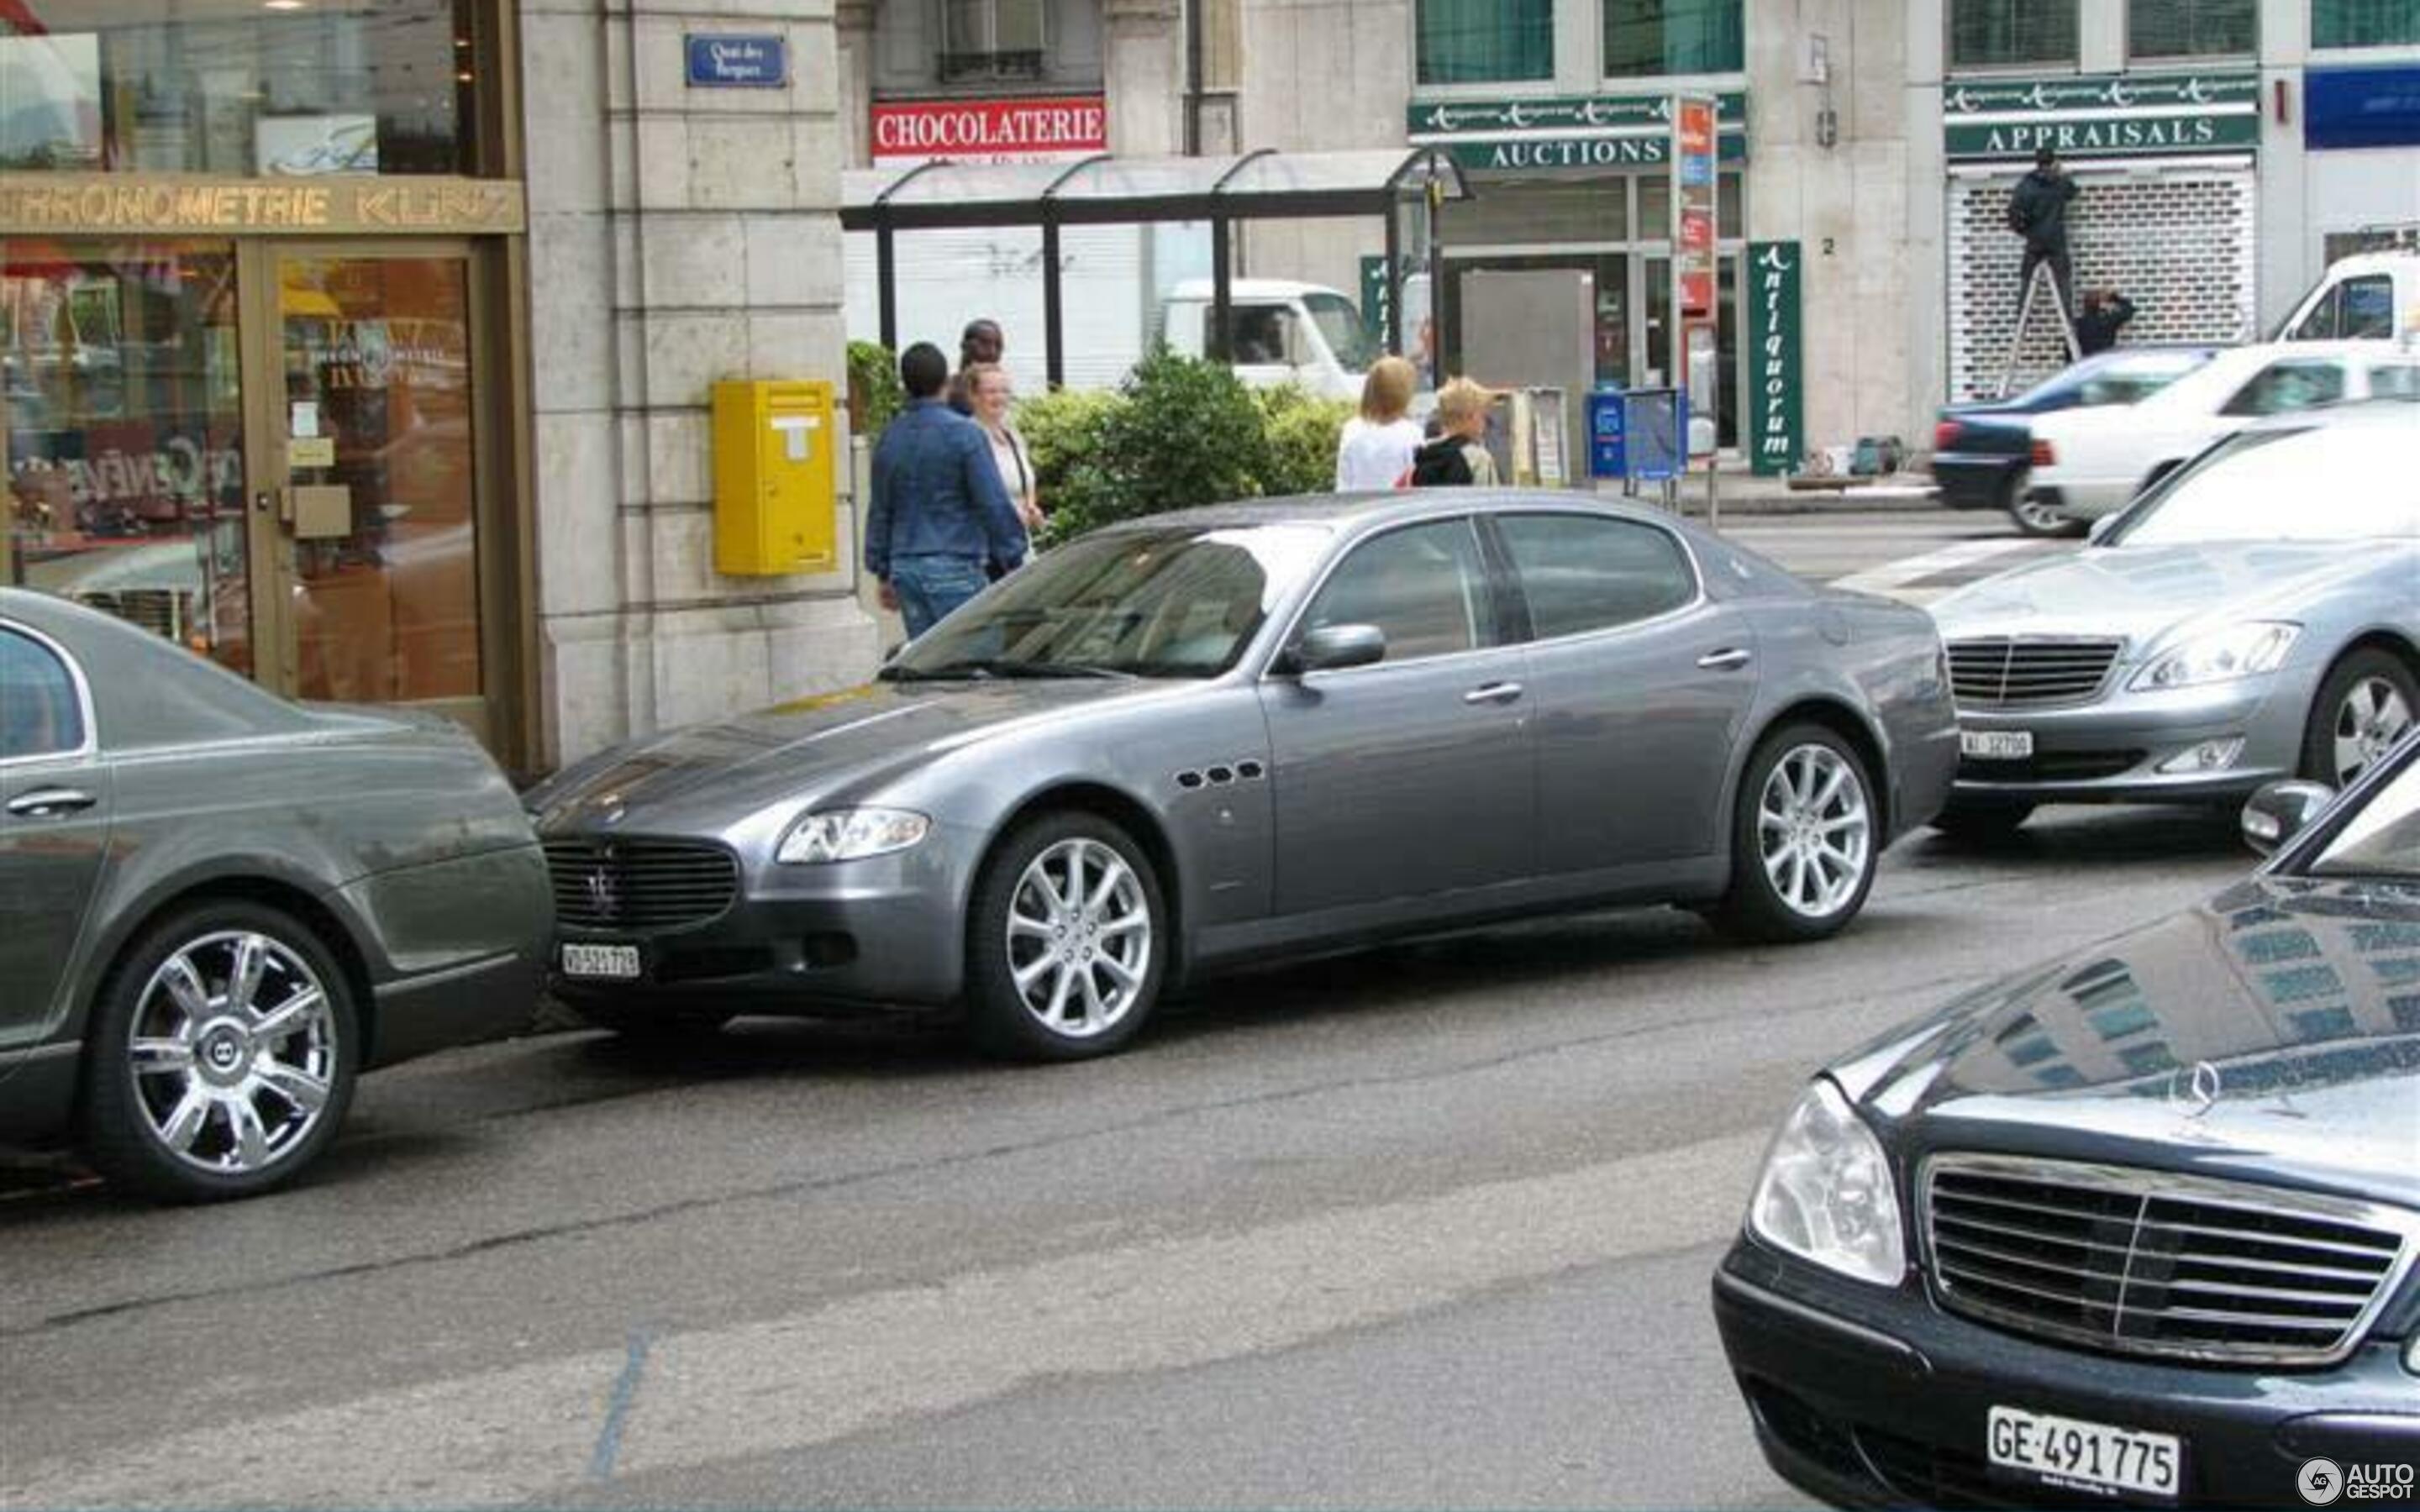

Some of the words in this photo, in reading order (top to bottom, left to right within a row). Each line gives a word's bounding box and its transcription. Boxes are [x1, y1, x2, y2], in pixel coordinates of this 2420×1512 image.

[877, 108, 1102, 147] CHOCOLATERIE
[1986, 117, 2214, 151] APPRAISALS
[1491, 140, 1662, 167] AUCTIONS
[1823, 238, 1835, 255] 2
[1757, 244, 1791, 454] Antiquorum
